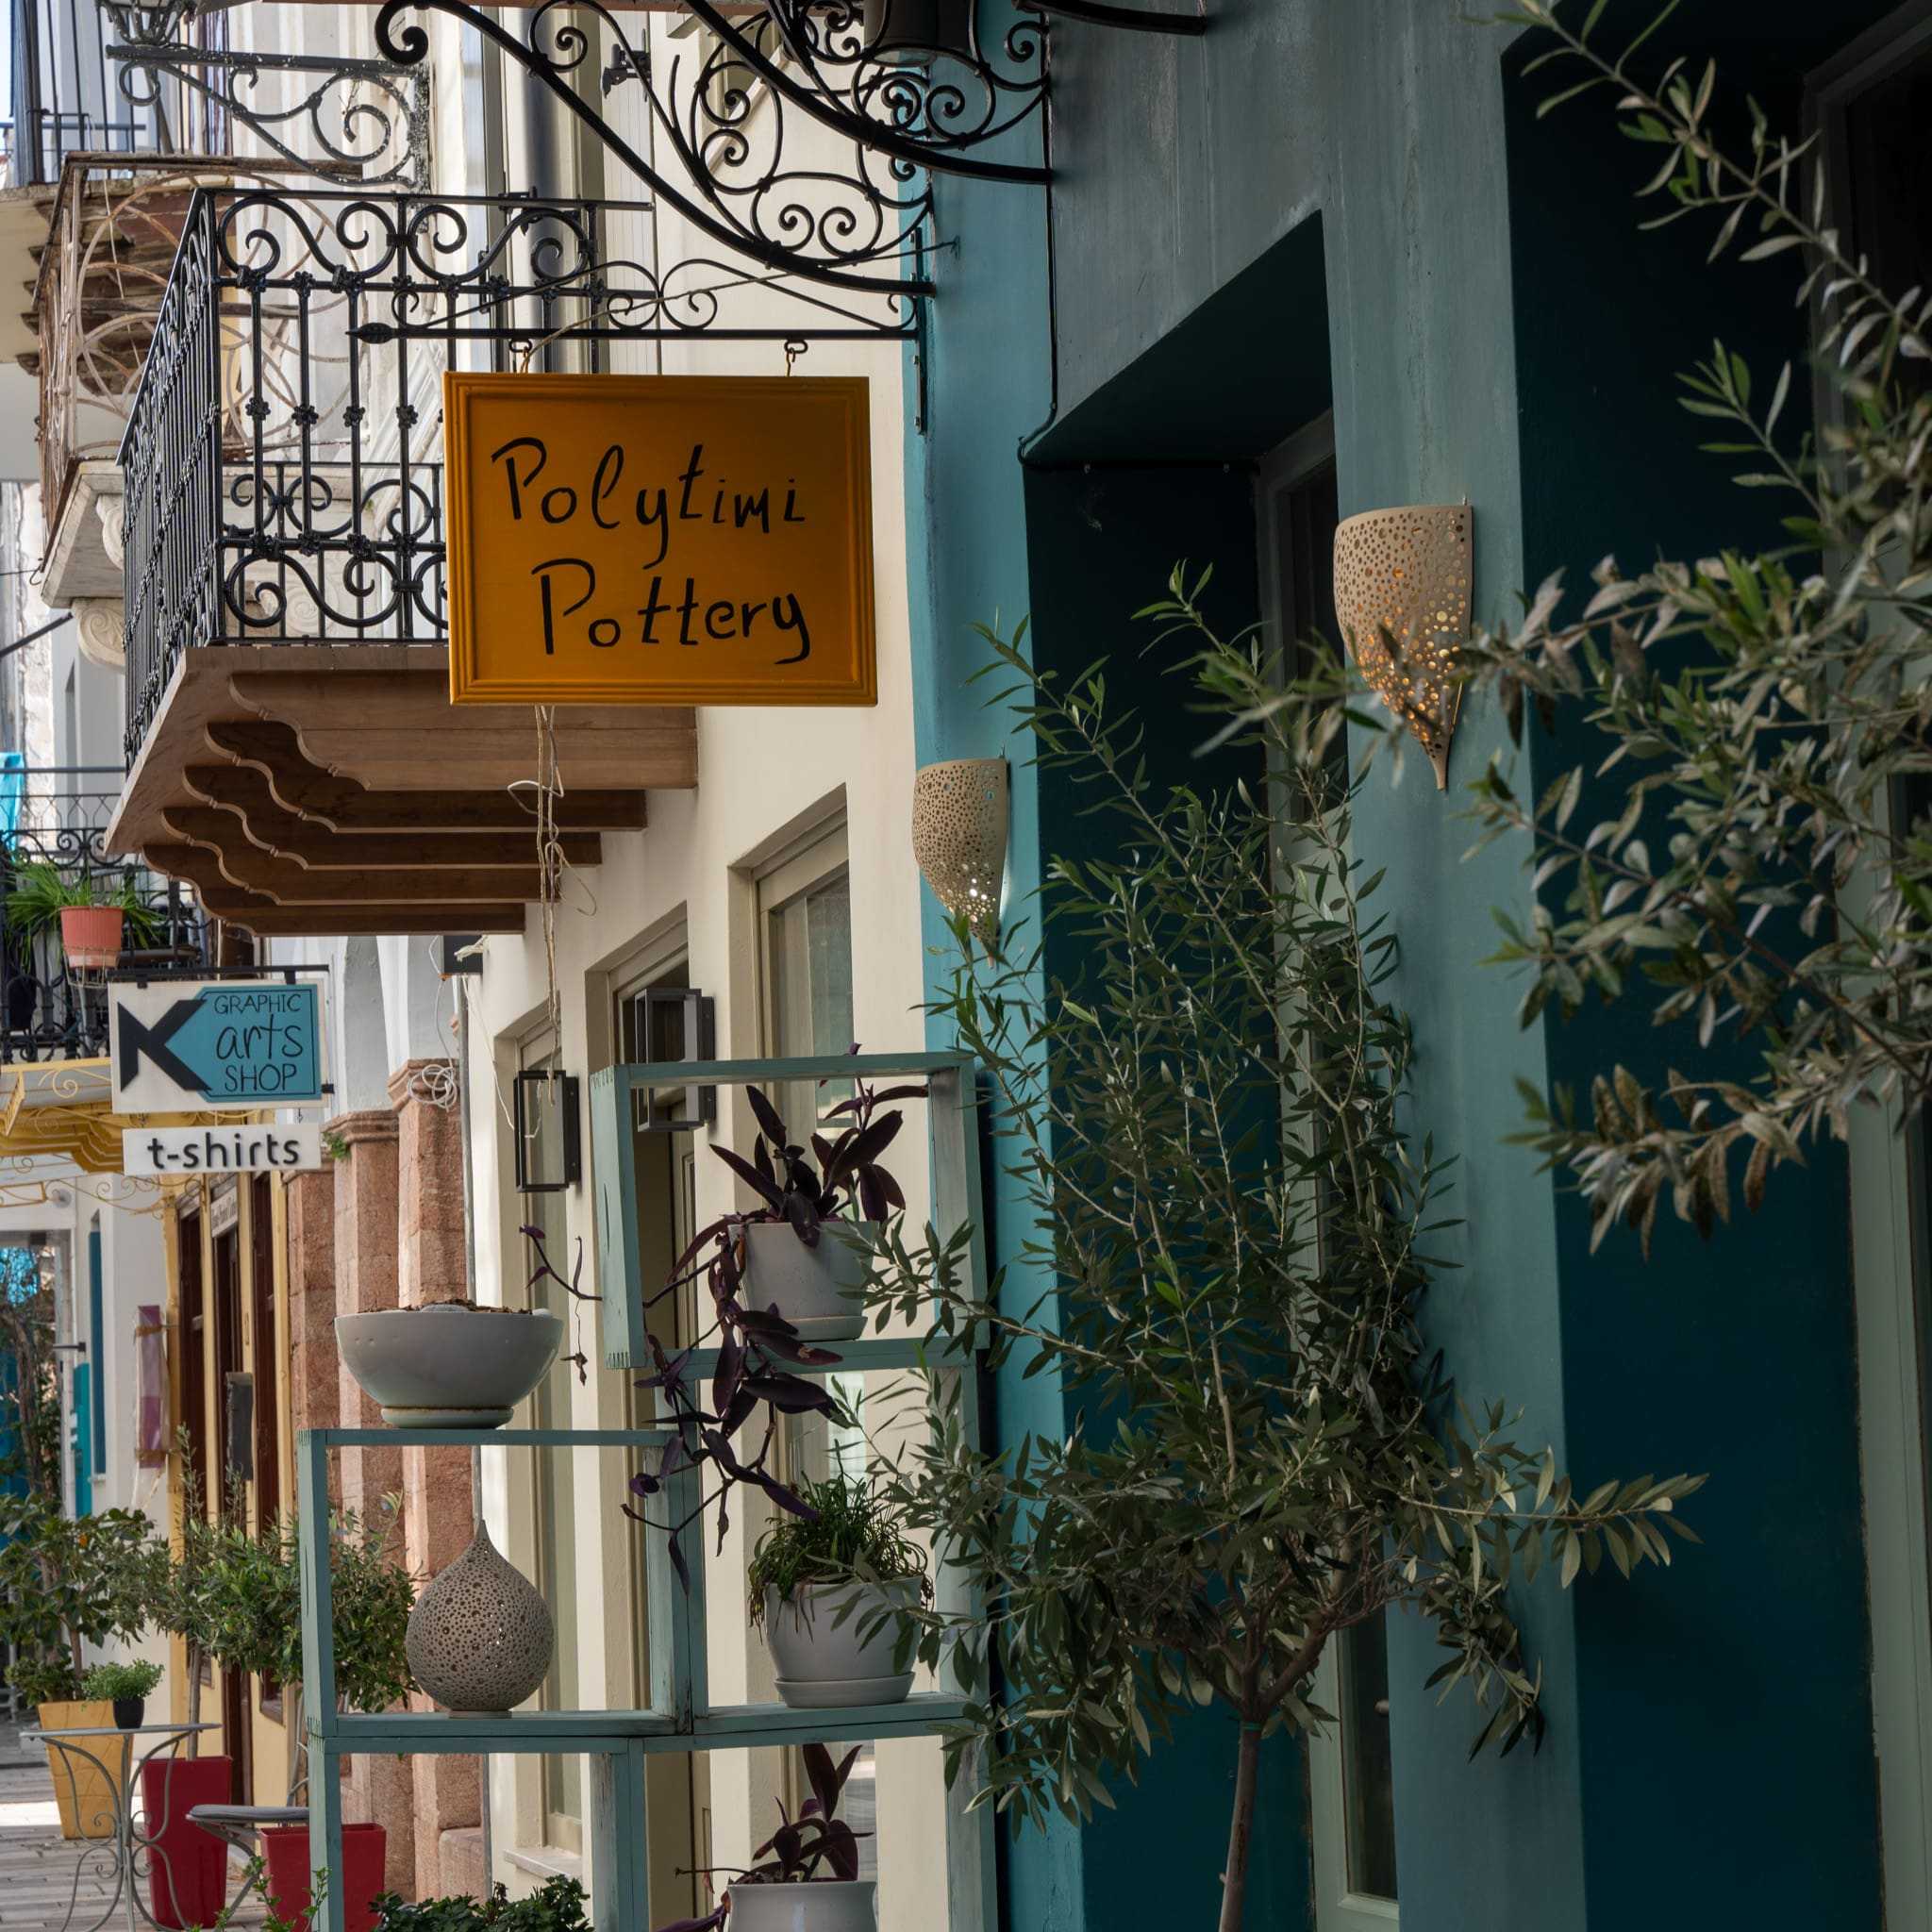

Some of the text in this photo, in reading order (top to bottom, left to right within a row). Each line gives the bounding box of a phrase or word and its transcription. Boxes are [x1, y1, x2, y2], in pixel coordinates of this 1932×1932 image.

[491, 436, 806, 569] Polytimi
[531, 558, 810, 664] Pottery
[214, 993, 301, 1014] GRAPHIC
[216, 1014, 303, 1060] arts
[225, 1064, 297, 1092] SHOP
[147, 1132, 299, 1169] t-shirts
